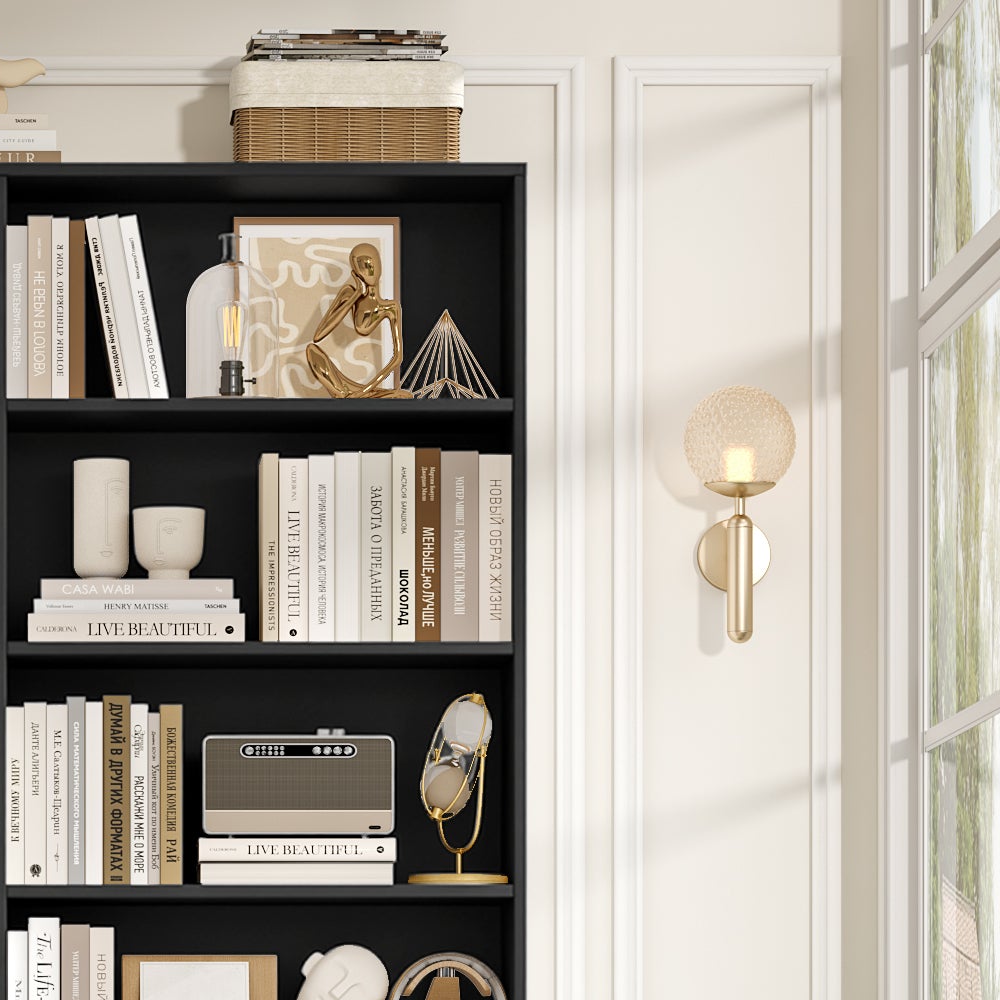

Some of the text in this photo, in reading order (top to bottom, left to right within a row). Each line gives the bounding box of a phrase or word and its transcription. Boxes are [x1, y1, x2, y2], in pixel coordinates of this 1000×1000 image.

[287, 510, 301, 542] LIVE
[369, 486, 383, 622] ЗАБОТА О ПРЕДАННЫХ
[490, 478, 504, 622] НОВЫЙ ОБРАЗ ЖИЗНИ
[62, 583, 136, 595] CASA WABI
[268, 540, 276, 632] THE IMPRESSIONISTS
[287, 544, 301, 622] BEAUTIFUL
[398, 570, 409, 626] ШОКОЛАД
[422, 590, 435, 628] ЛУЧШЕ
[88, 622, 124, 636] LIVE
[128, 622, 216, 636] BEAUTIFUL
[31, 722, 39, 750] ДАНТЕ
[109, 702, 126, 744] ДУМАЙ
[110, 748, 123, 756] В
[72, 722, 80, 864] СИЛА МАТЕМАТИЧЕСКОГО МЫШЛЕНИЯ
[109, 760, 123, 804] ДРУГИХ
[134, 776, 144, 820] РАССКАЖИ
[150, 764, 160, 799] Уличный
[166, 726, 177, 832] БОЖЕСТВЕННАЯ КОМЕДИЯ
[109, 808, 123, 870] ФОРМАТАХ
[134, 822, 144, 840] МНЕ
[167, 838, 180, 862] РАЙ
[246, 844, 280, 855] LIVE
[282, 844, 364, 855] BEAUTIFUL
[134, 850, 144, 874] МОРЕ
[151, 854, 160, 870] Боб
